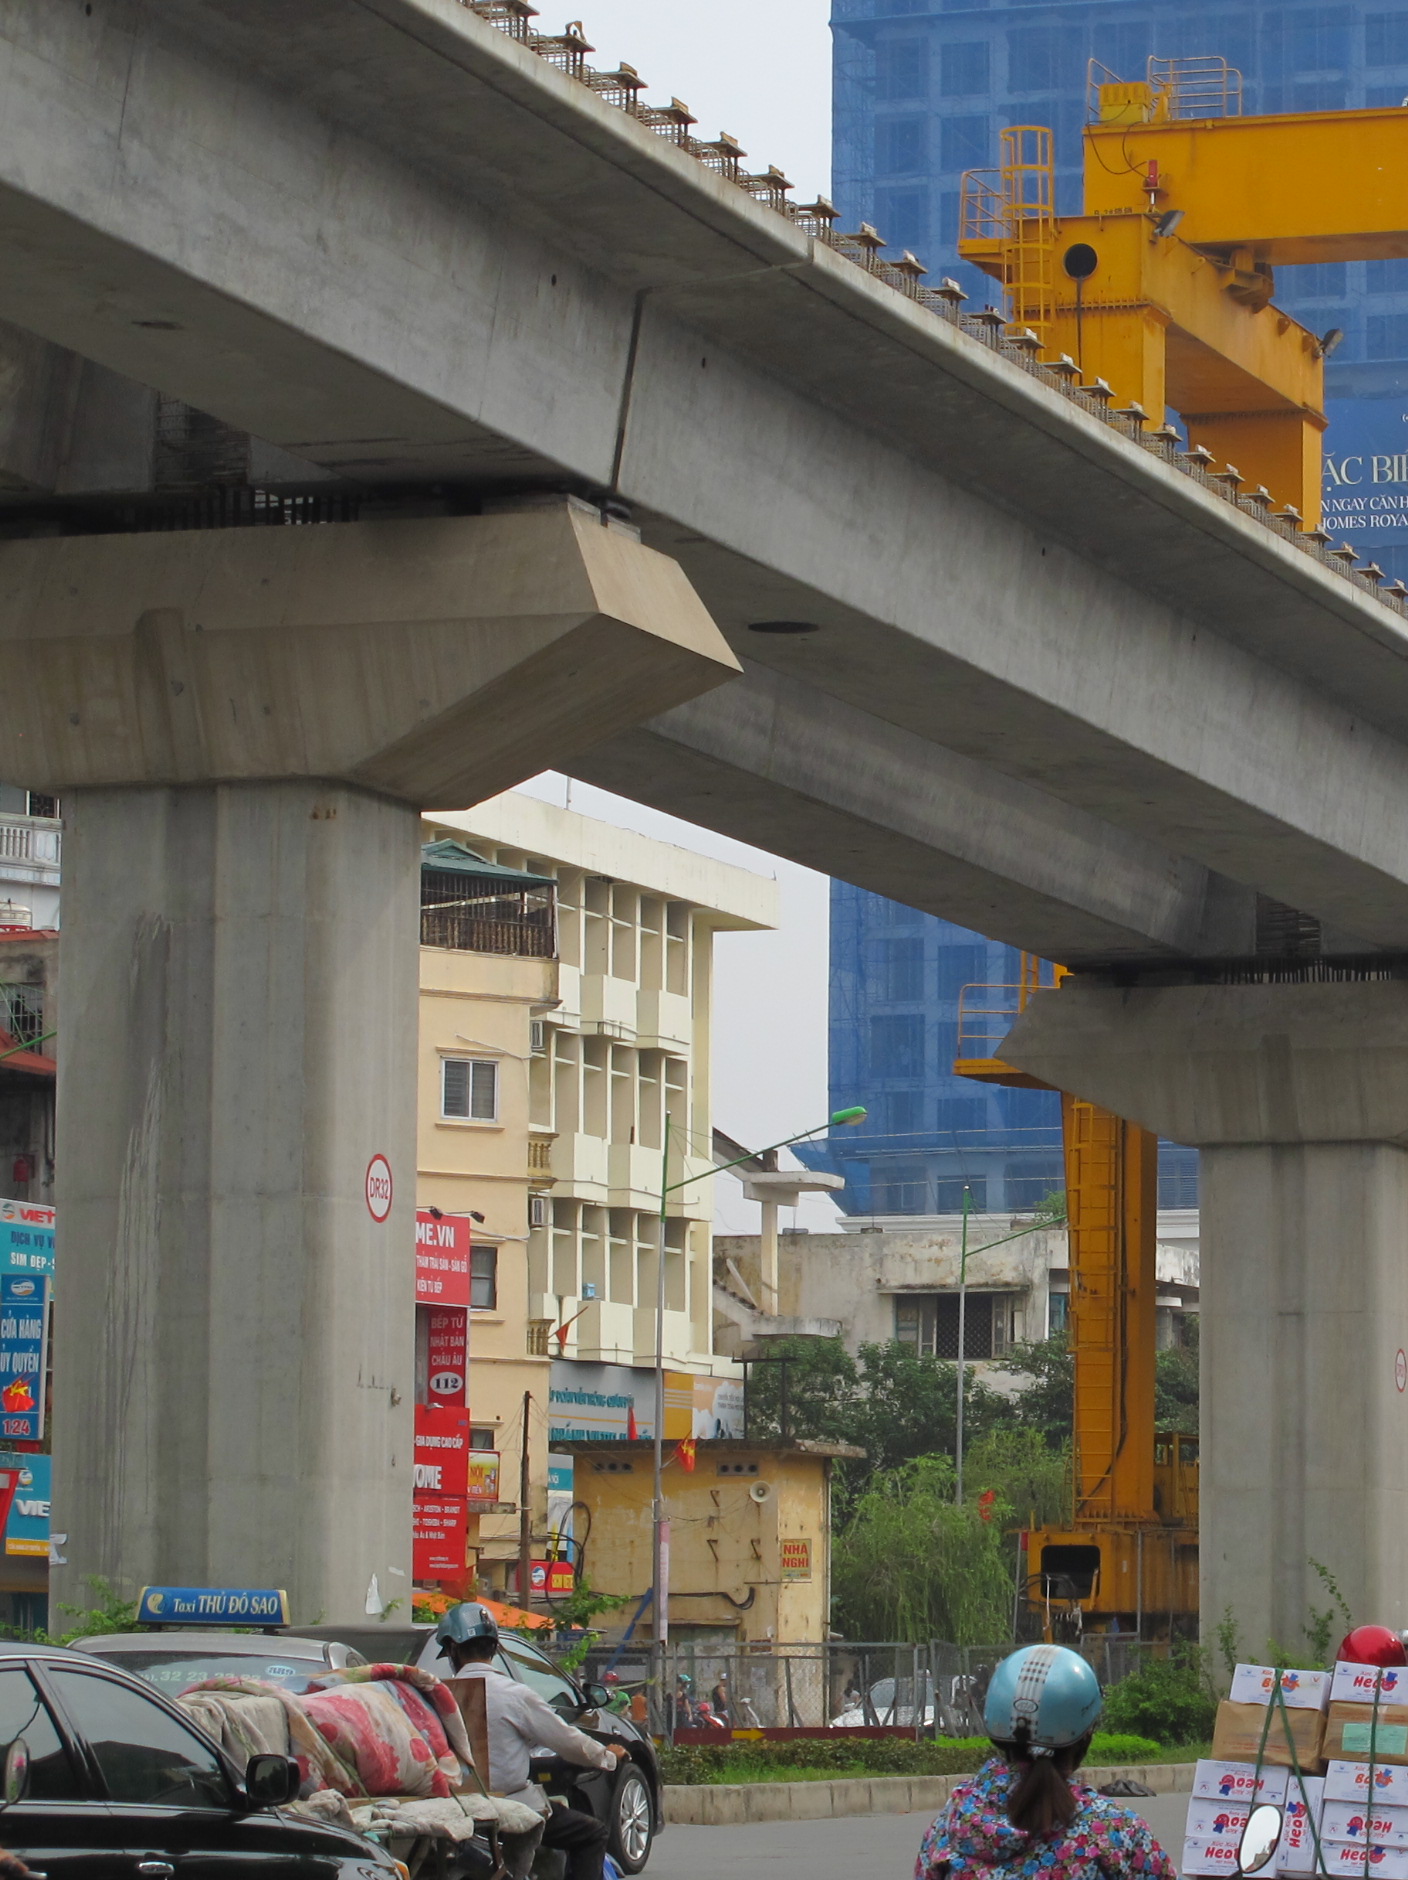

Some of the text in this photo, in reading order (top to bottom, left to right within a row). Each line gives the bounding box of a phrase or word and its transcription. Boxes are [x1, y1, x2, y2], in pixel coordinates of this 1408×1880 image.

[1332, 497, 1367, 512] NGAY
[1370, 494, 1398, 510] CĂN
[370, 1177, 389, 1200] DR32
[416, 1222, 455, 1248] ME.VN
[10, 1252, 27, 1266] SIM
[19, 1315, 42, 1339] HÀNG
[435, 1378, 458, 1389] 112
[3, 1419, 30, 1435] 124
[413, 1464, 442, 1489] OME
[174, 1591, 278, 1614] Taxi THỦ ĐÔ SAO
[1205, 1847, 1233, 1859] Heo
